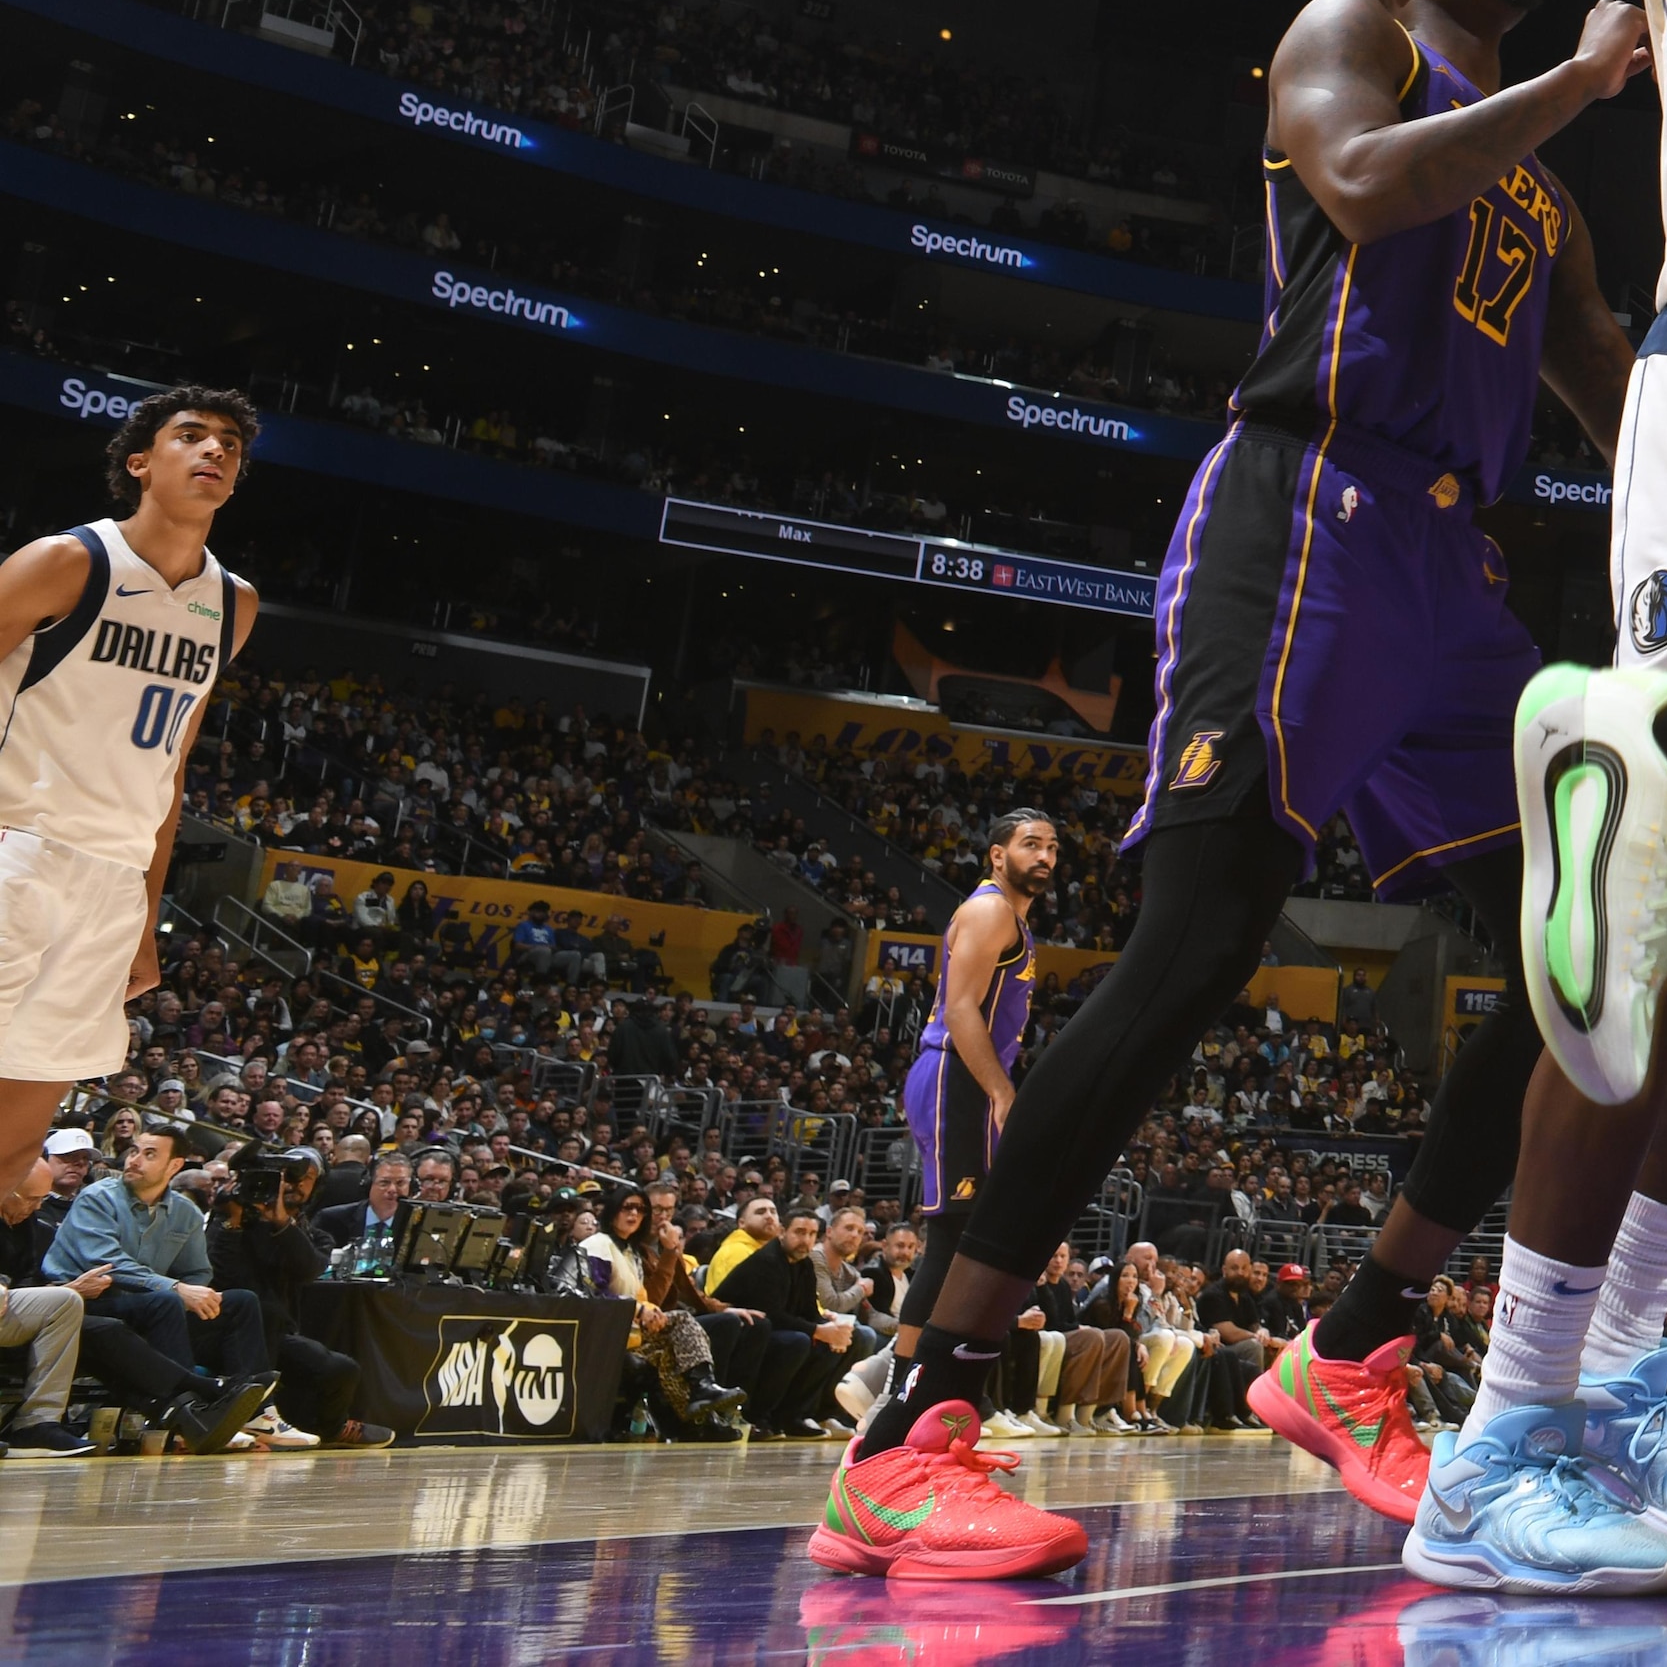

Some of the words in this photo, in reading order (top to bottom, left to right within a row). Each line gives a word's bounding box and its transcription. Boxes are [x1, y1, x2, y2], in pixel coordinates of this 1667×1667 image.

[398, 92, 522, 148] Spectrum
[883, 143, 928, 162] TOYOTA
[986, 167, 1030, 185] TOYOTA
[911, 224, 1023, 268] Spectrum
[1452, 196, 1537, 348] 17
[431, 270, 569, 329] Spectrum
[60, 378, 141, 419] Spec
[1006, 396, 1129, 441] Spectrum
[1534, 474, 1612, 504] Spectr
[778, 524, 812, 544] Max
[931, 552, 985, 581] 8:38
[187, 600, 221, 622] chime
[89, 618, 217, 686] DALLAS
[131, 683, 198, 757] 00
[836, 721, 959, 759] LOS
[470, 902, 515, 918] LOS
[888, 945, 926, 968] 114
[1464, 992, 1498, 1012] 115
